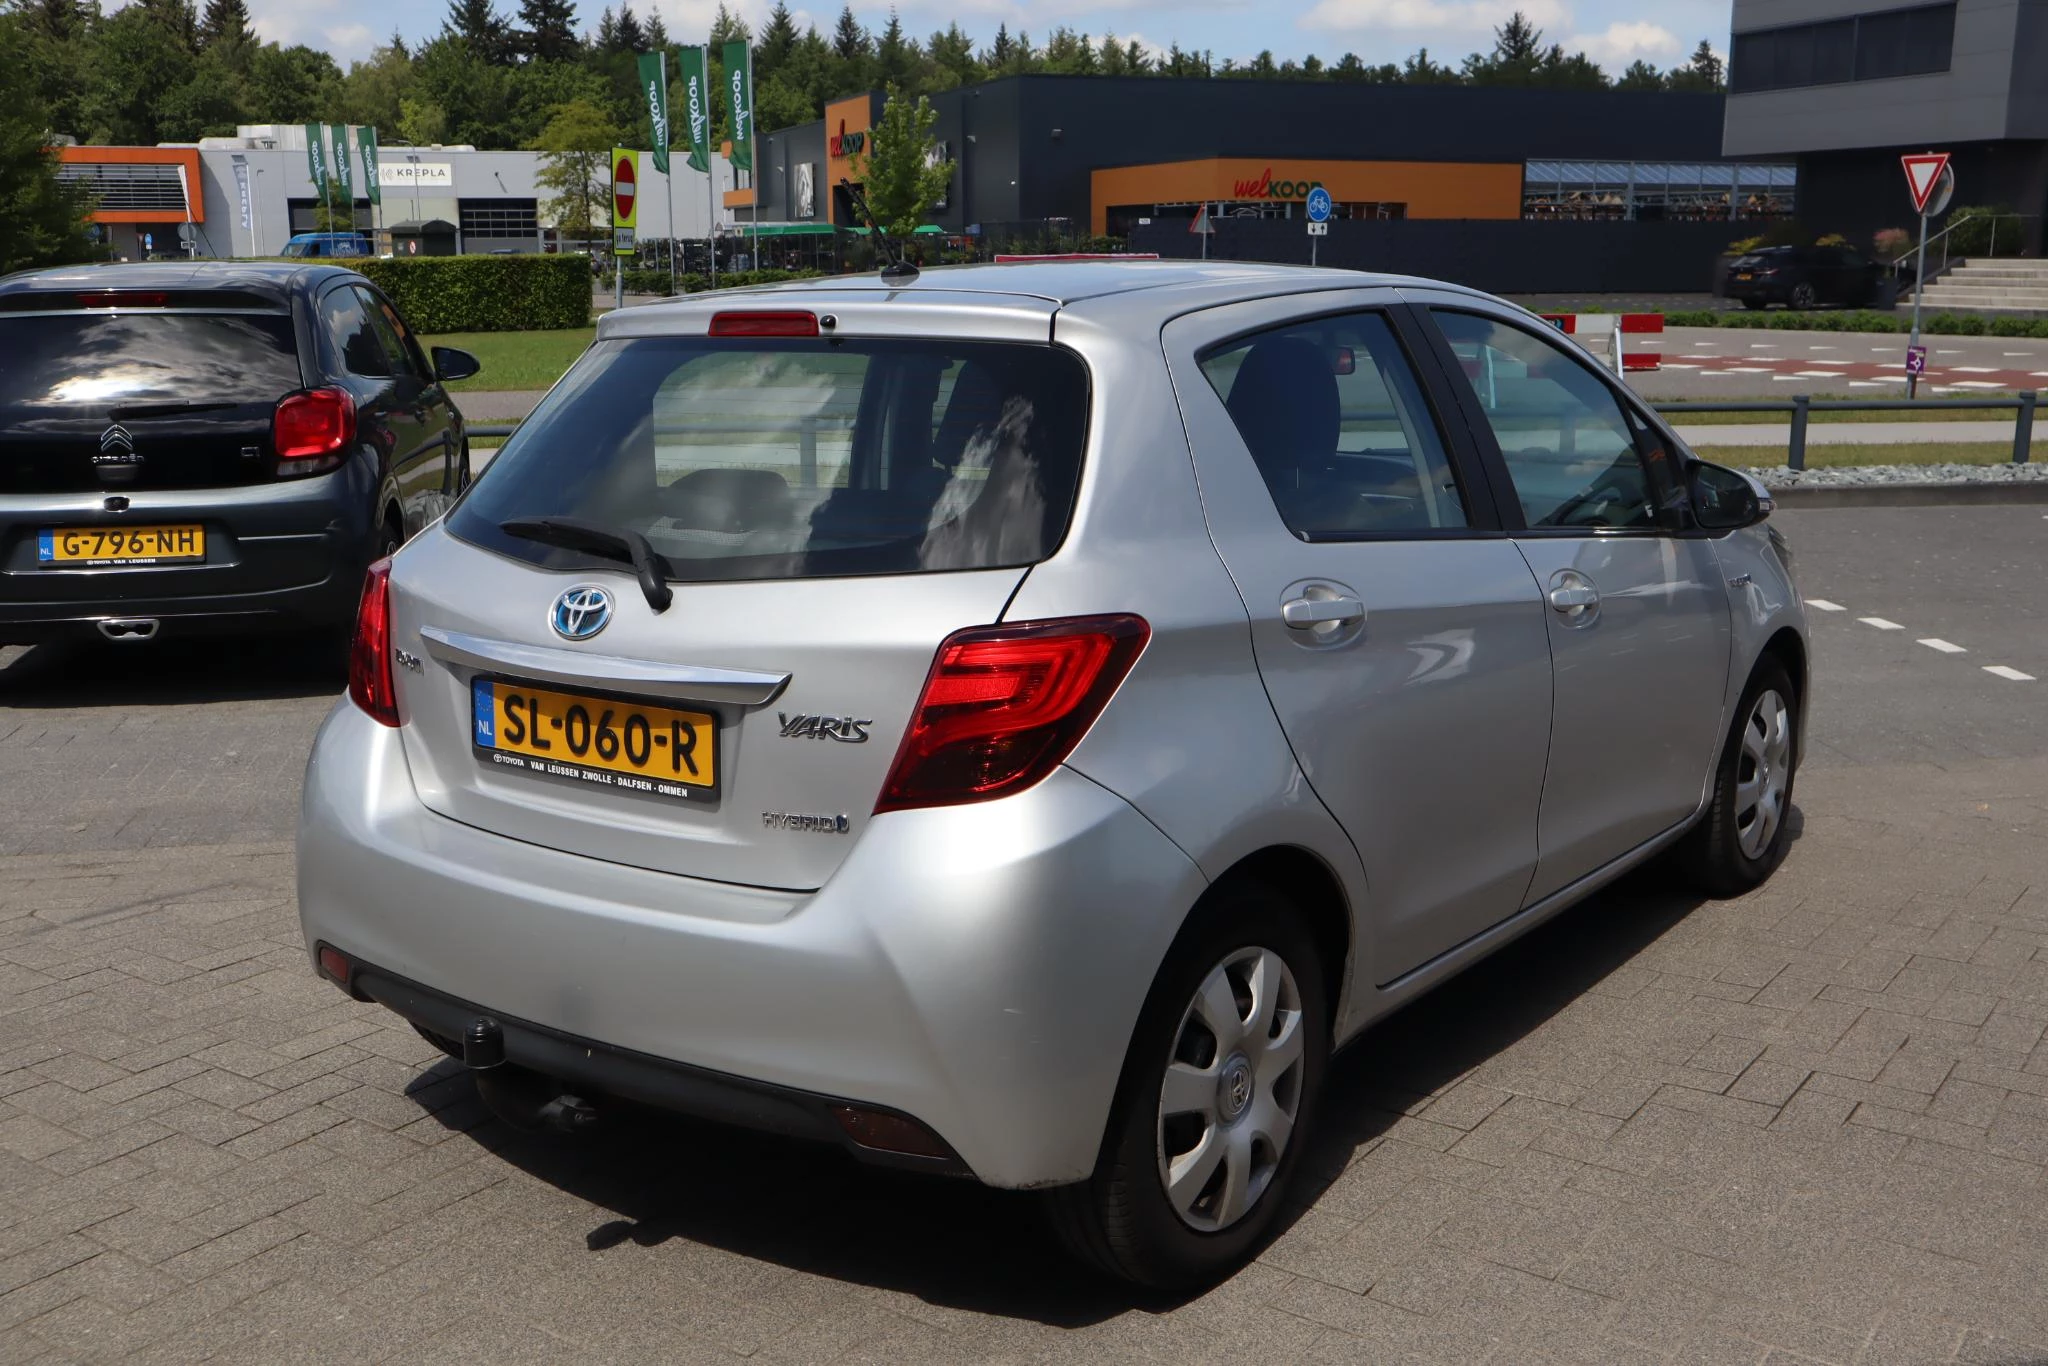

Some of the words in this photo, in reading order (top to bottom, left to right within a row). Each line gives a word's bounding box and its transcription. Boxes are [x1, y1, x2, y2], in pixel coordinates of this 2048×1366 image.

[396, 168, 446, 177] KREPLA
[40, 547, 52, 555] NL
[62, 528, 195, 556] G-796-NH
[478, 719, 493, 736] NL
[503, 694, 699, 777] SL-060-R
[502, 755, 525, 767] TOYOTA
[530, 760, 545, 772] VAN
[547, 764, 580, 778] LEUSSEN
[582, 770, 612, 784] ZWOLLE
[617, 777, 652, 791] DALFSEN
[658, 785, 688, 797] OMMEN
[762, 810, 837, 833] HYBRID
